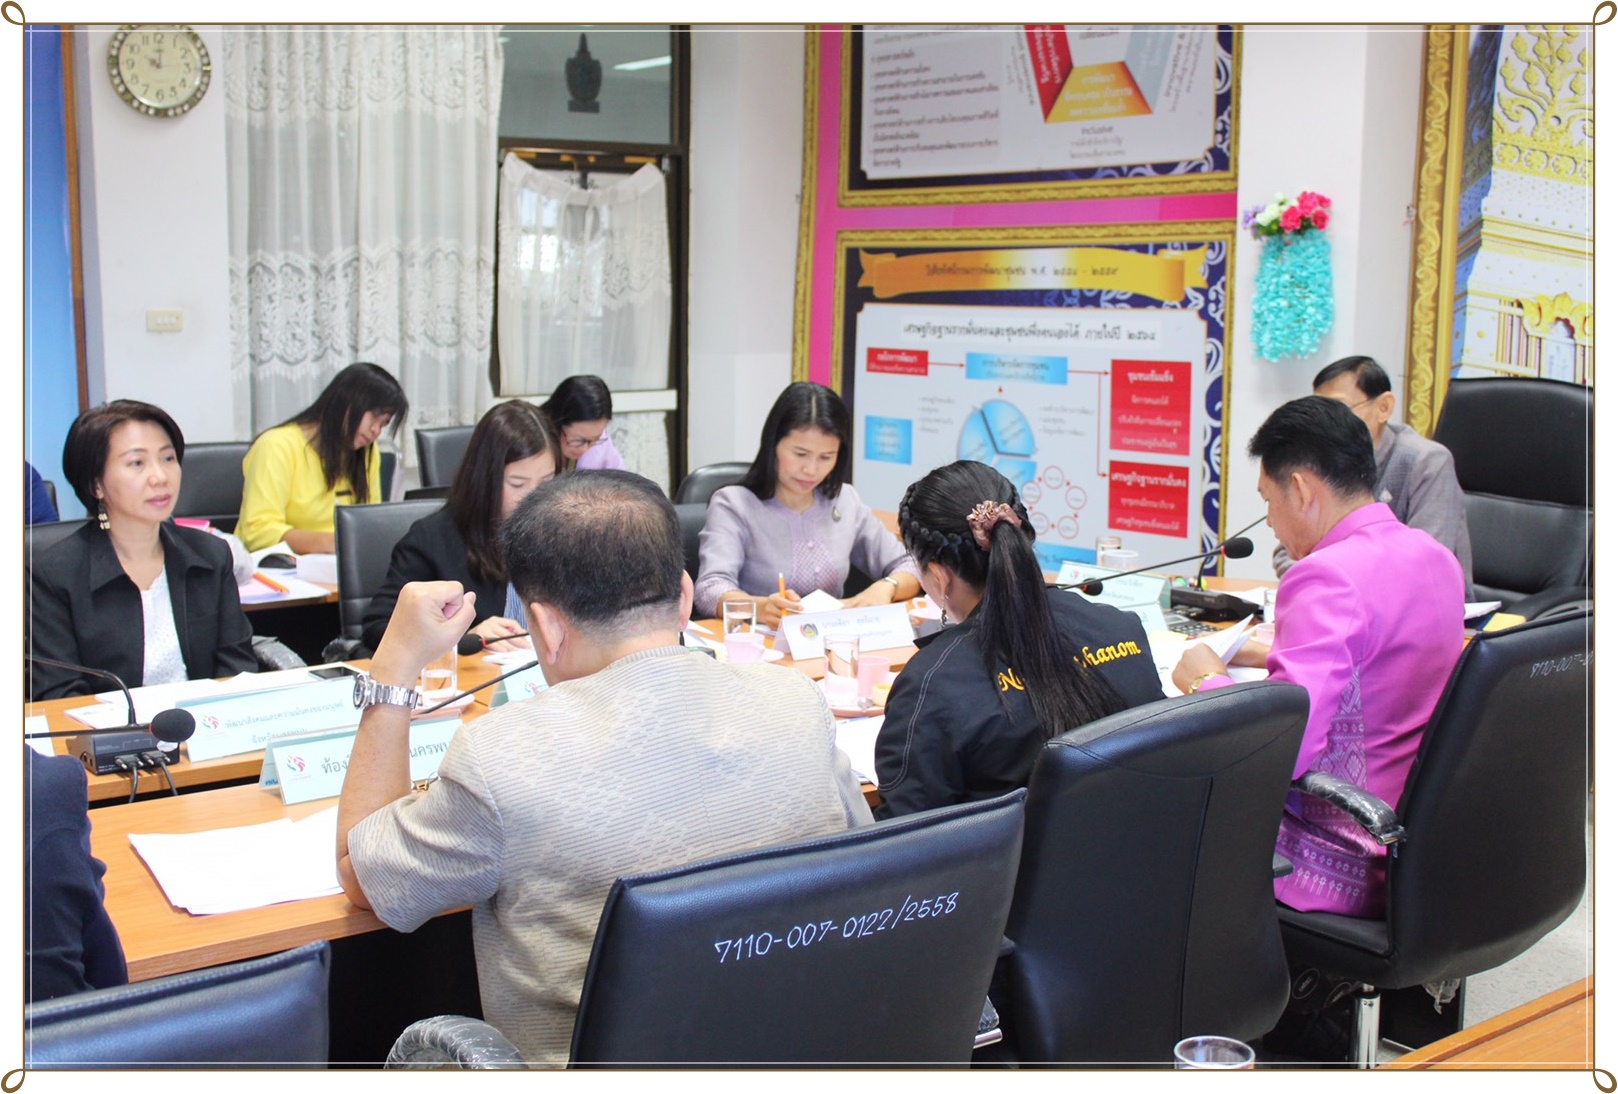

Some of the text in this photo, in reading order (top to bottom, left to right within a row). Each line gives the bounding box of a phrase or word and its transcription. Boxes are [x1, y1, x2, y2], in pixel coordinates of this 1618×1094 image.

[126, 58, 135, 70] 9
[184, 62, 192, 74] 3
[141, 84, 150, 96] 7
[156, 89, 165, 101] 6
[169, 86, 178, 97] 5
[1073, 639, 1142, 671] hanom
[713, 891, 960, 964] 7110-007-0122/2558
